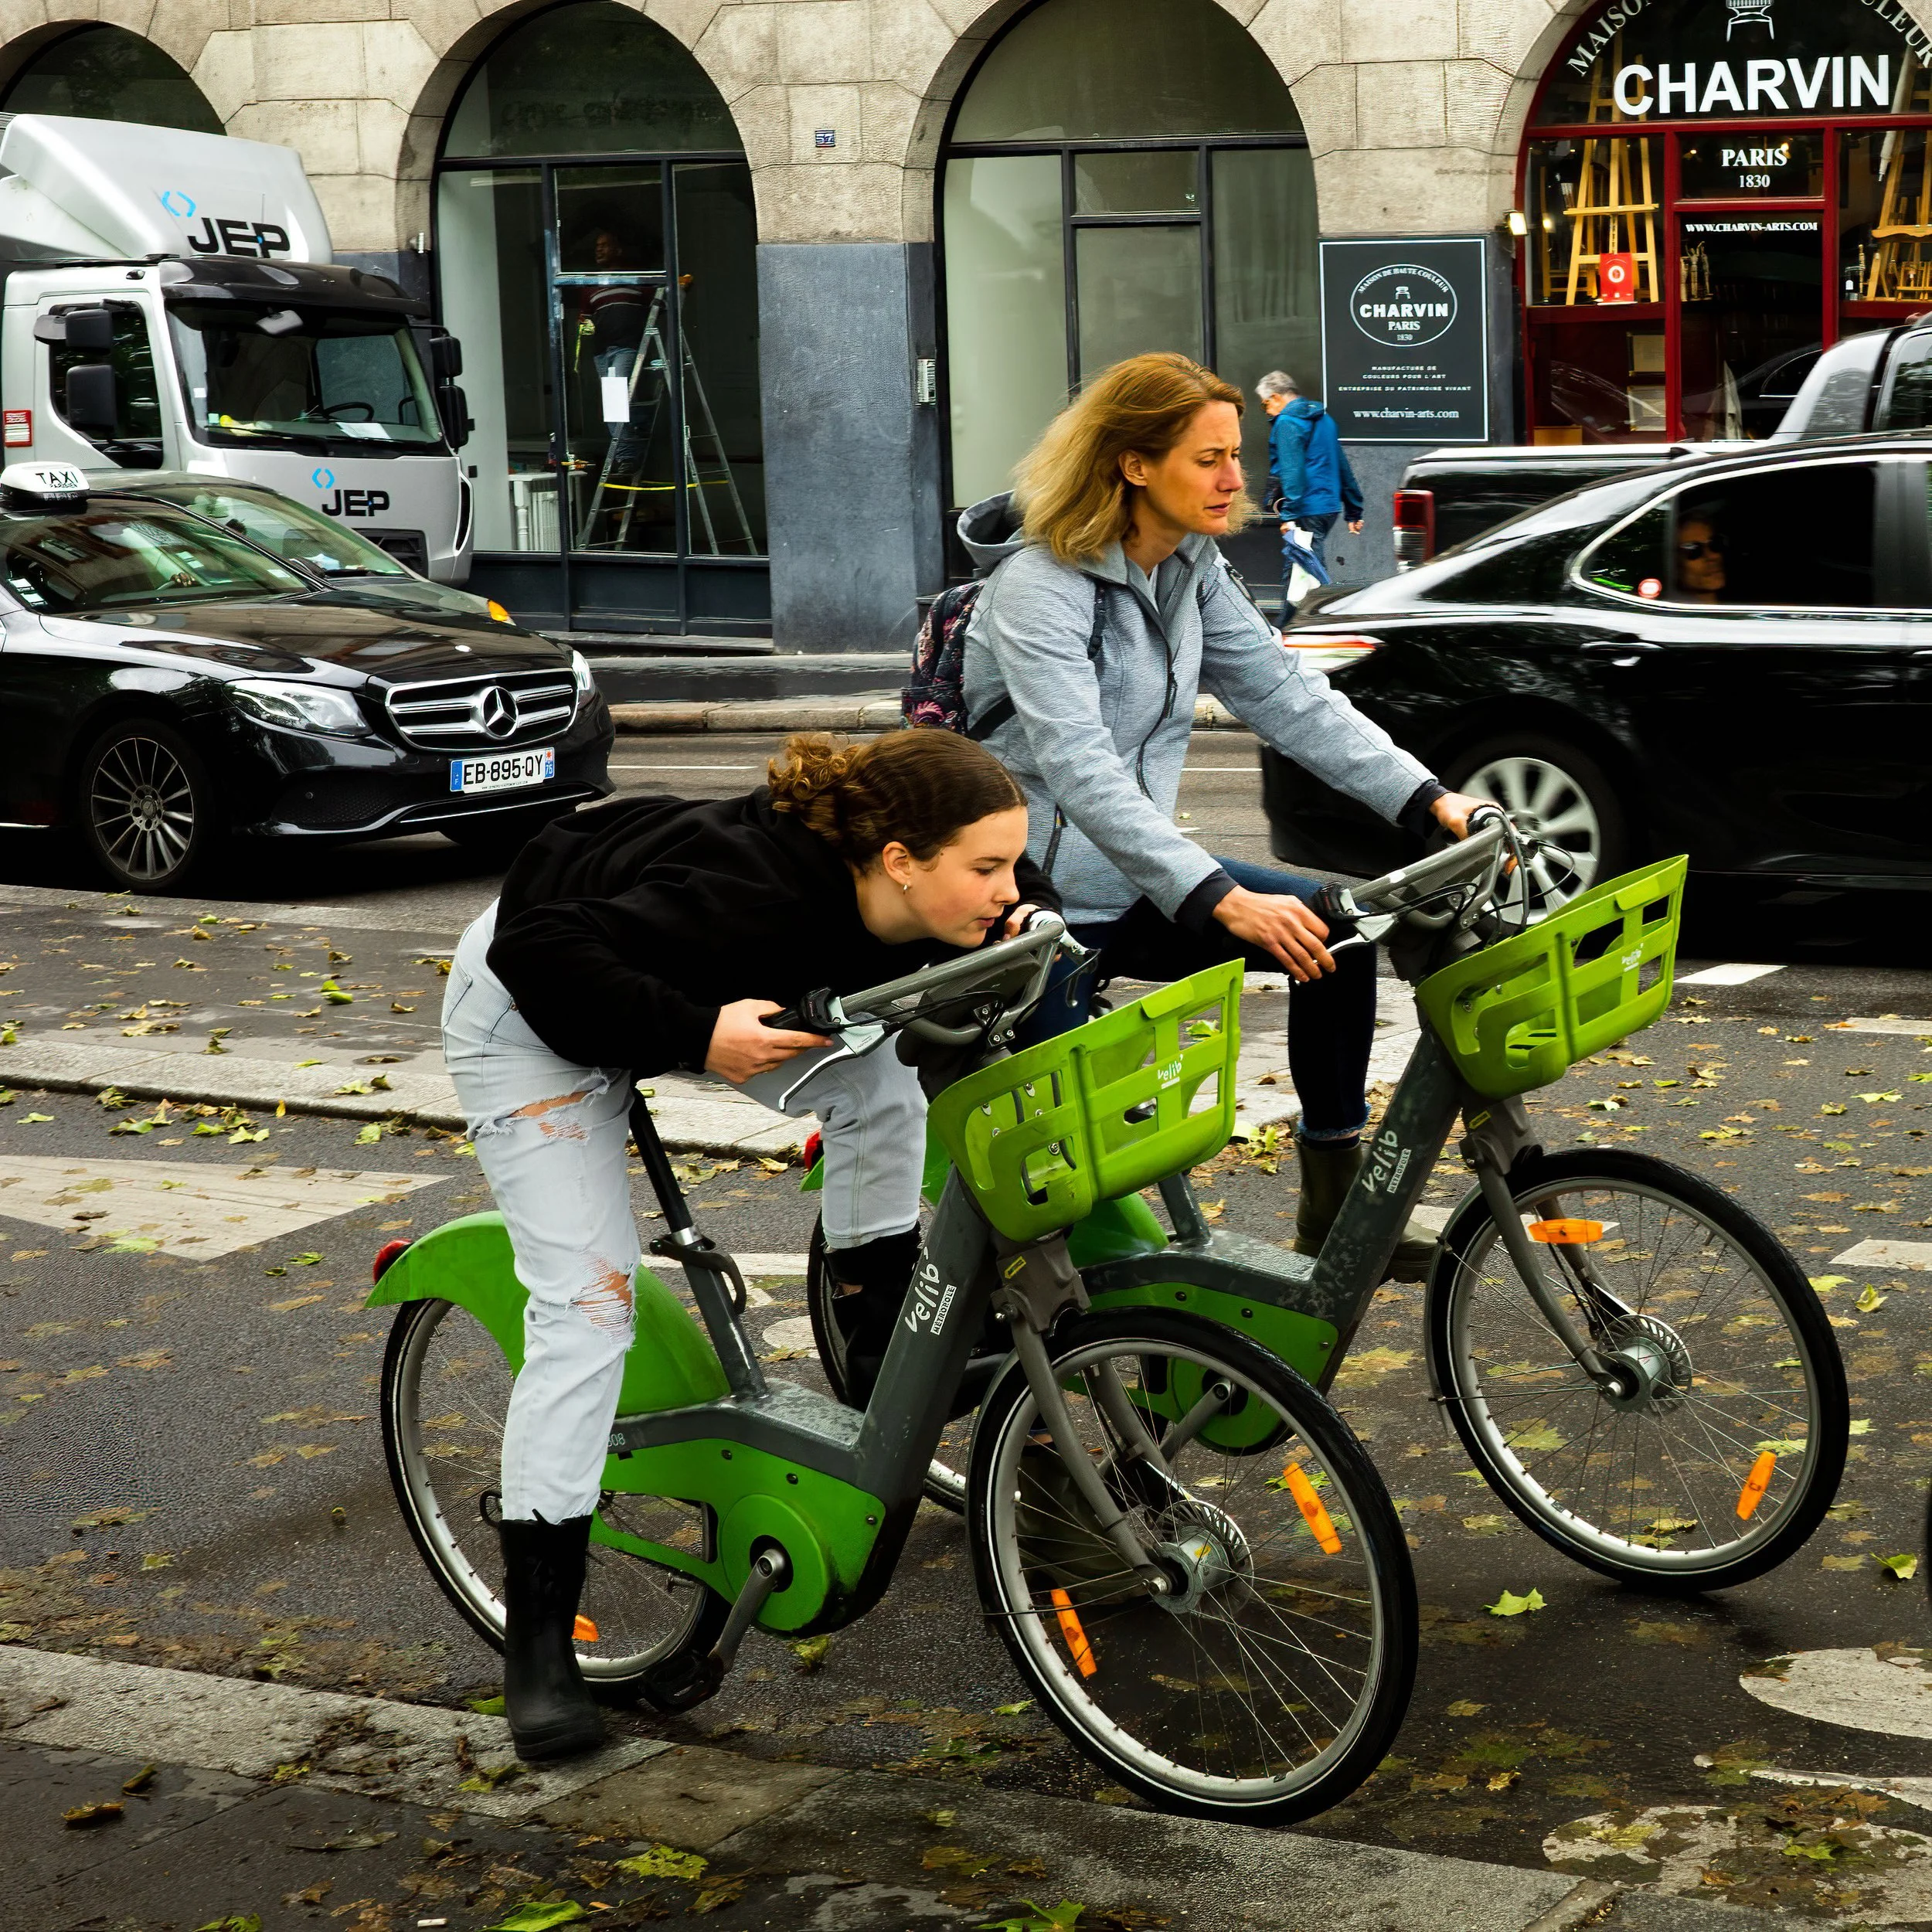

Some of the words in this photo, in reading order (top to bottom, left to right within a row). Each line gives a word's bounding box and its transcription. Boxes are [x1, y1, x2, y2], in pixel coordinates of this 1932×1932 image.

[1566, 0, 1652, 77] MAISO
[1614, 55, 1889, 115] CHARVIN
[1721, 148, 1787, 167] PARIS
[1740, 175, 1770, 188] 1830
[1685, 222, 1818, 232] WWW.CHARVIN-ARTS.COM
[187, 217, 291, 258] JEP
[1358, 272, 1383, 294] MAISON
[1417, 270, 1449, 293] COULEUR
[1359, 303, 1449, 318] CHARVIN
[1388, 321, 1420, 331] PARIS
[1352, 407, 1460, 418] www.charvin-arts.com
[35, 471, 79, 488] TAXI
[321, 489, 390, 516] JEP
[464, 754, 543, 785] EB-895-QY
[545, 764, 553, 775] 75
[932, 1286, 956, 1334] METROPOLE
